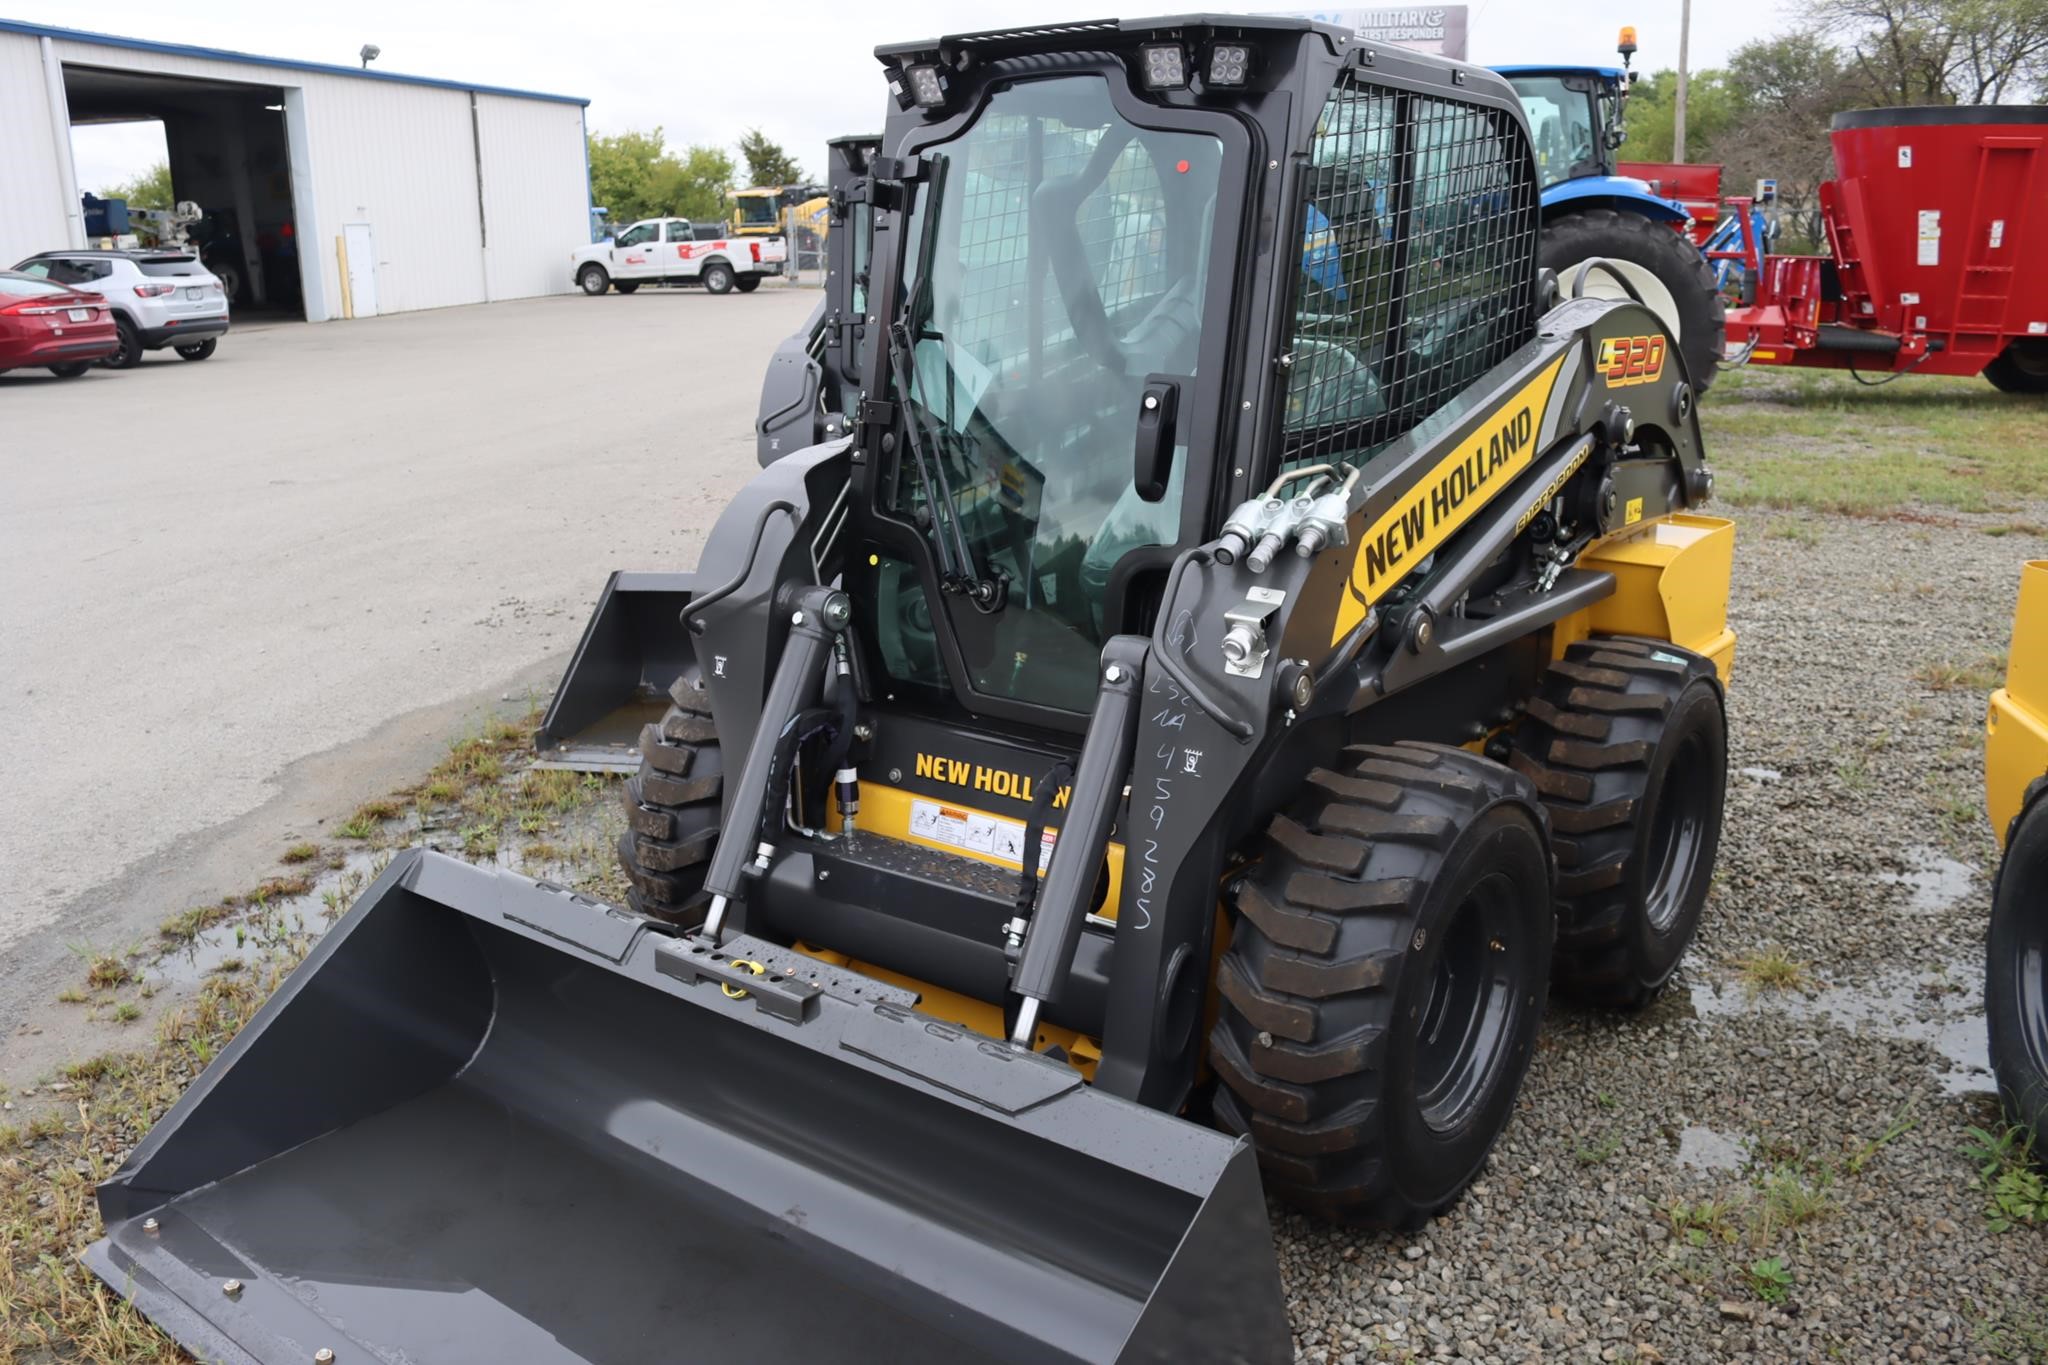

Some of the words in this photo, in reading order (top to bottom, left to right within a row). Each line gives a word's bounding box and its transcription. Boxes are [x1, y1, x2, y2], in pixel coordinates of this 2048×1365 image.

[1388, 27, 1444, 40] RESPONDER
[1597, 335, 1666, 387] L320
[1365, 497, 1425, 587] NEW
[1431, 406, 1532, 527] HOLLAND
[915, 752, 971, 786] NEW
[974, 765, 1072, 810] HOLLN
